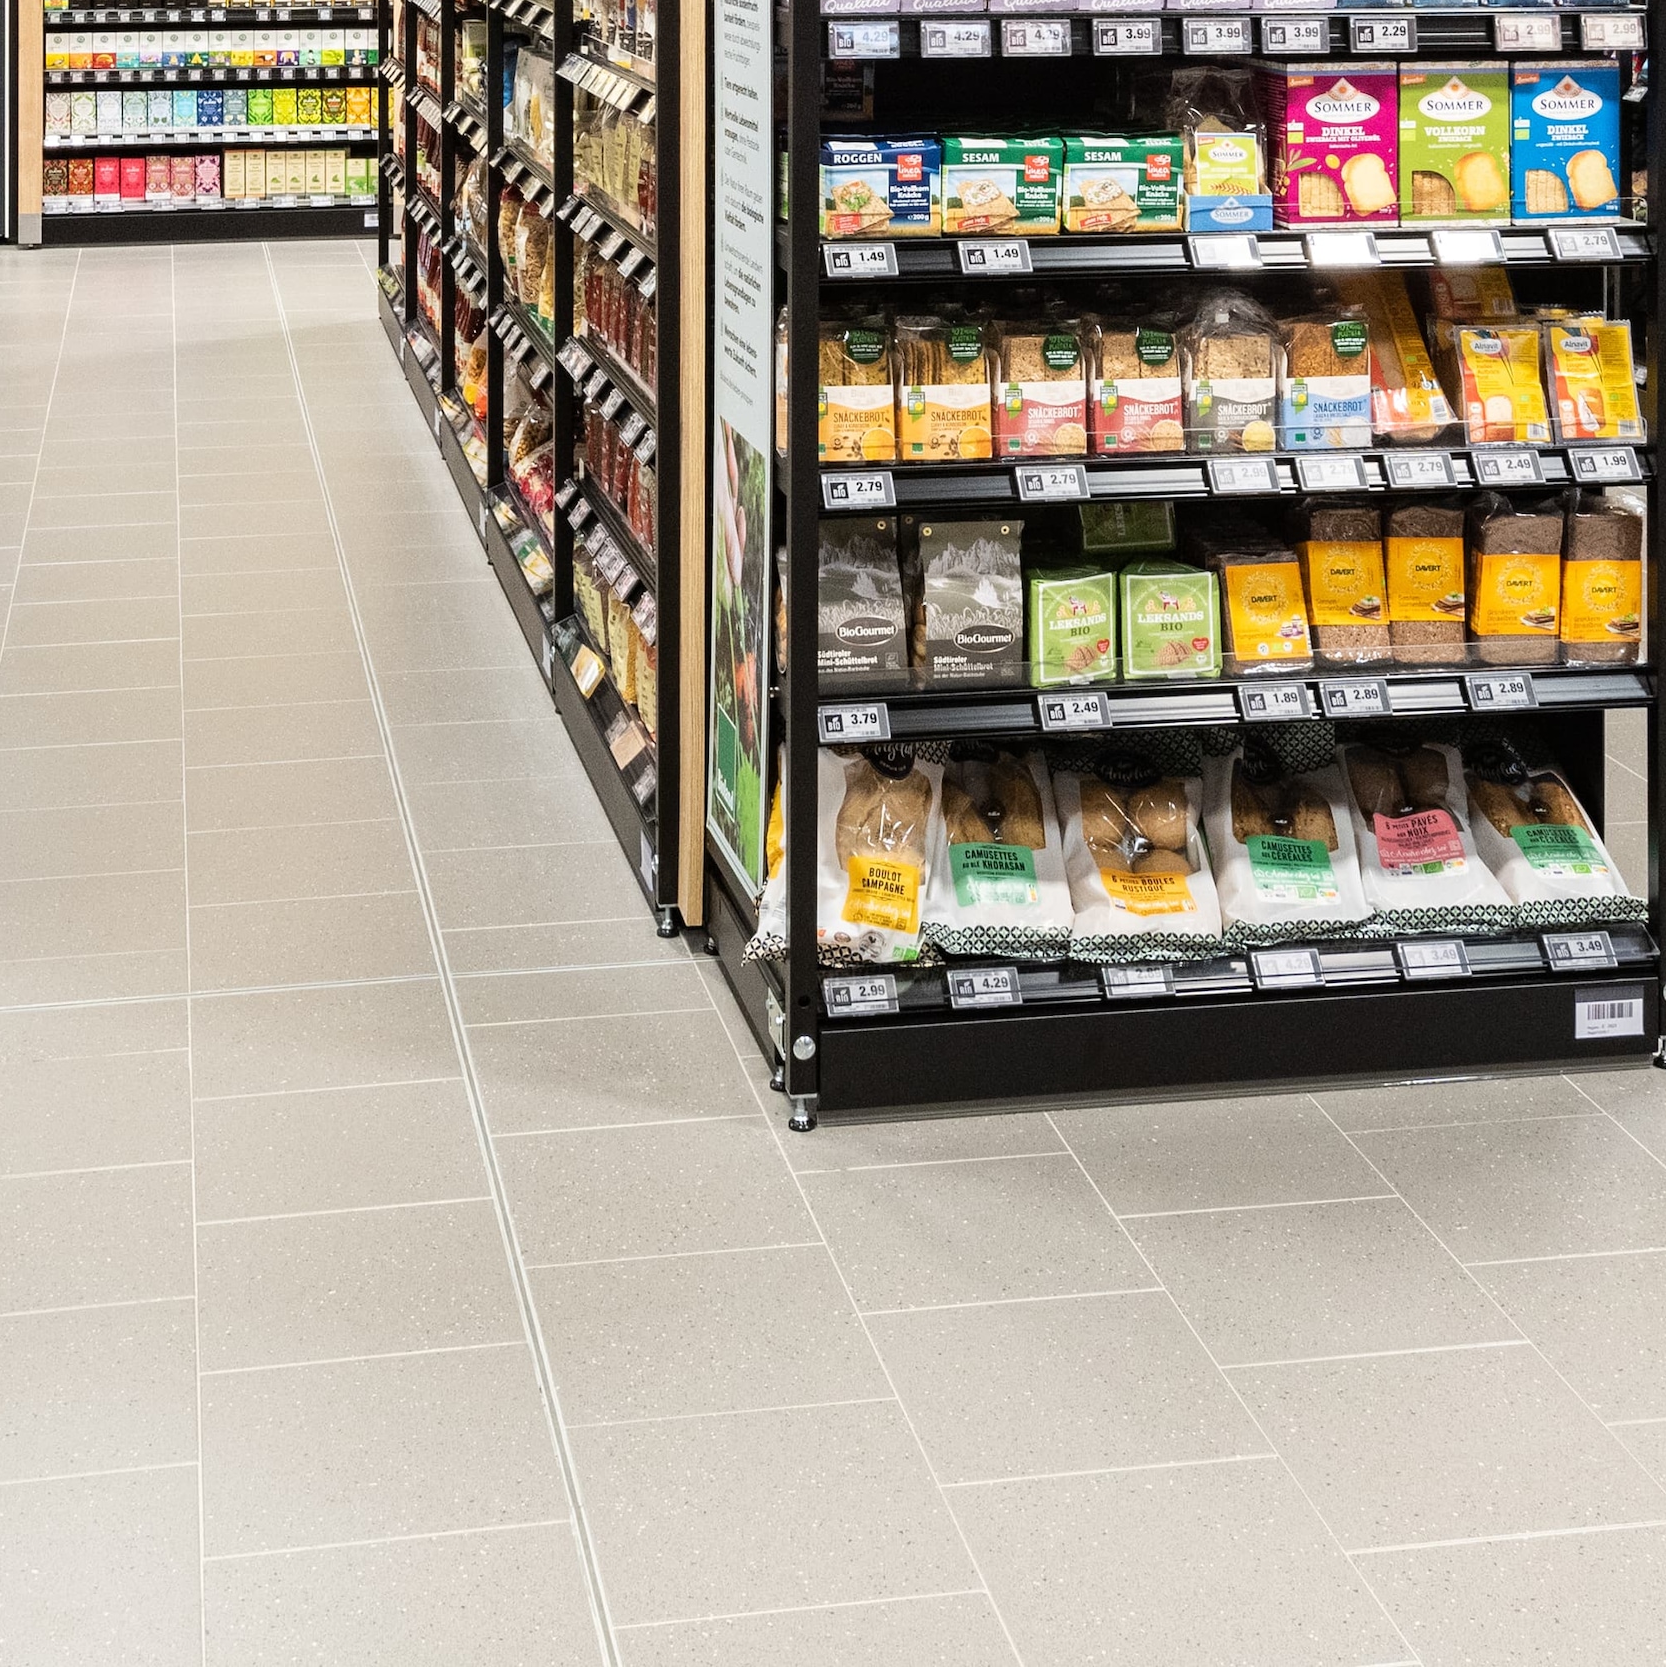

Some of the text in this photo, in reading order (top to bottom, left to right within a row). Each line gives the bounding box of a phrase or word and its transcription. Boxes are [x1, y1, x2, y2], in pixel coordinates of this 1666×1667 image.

[1125, 28, 1151, 40] 3.99
[1314, 100, 1373, 113] SOMMER
[1321, 126, 1365, 136] DINKEL
[1424, 125, 1486, 137] VOLLKORN
[834, 153, 882, 164] ROGGEN
[961, 152, 1000, 163] SESAM
[1602, 454, 1627, 466] 1.99
[856, 480, 883, 492] 2.79
[1330, 568, 1355, 576] DAVERT
[1137, 611, 1205, 623] LEKSANDS
[838, 625, 896, 638] BioGourmet
[1160, 622, 1183, 631] BIO
[1272, 692, 1299, 704] 1.89
[965, 849, 1018, 861] CAMUSETTES
[982, 860, 1026, 871] KHORASAN
[868, 867, 902, 882] BOULOT
[861, 878, 905, 895] CAMPAGNE
[1122, 883, 1165, 893] RUSTIQUE
[982, 977, 1009, 989] 4.29
